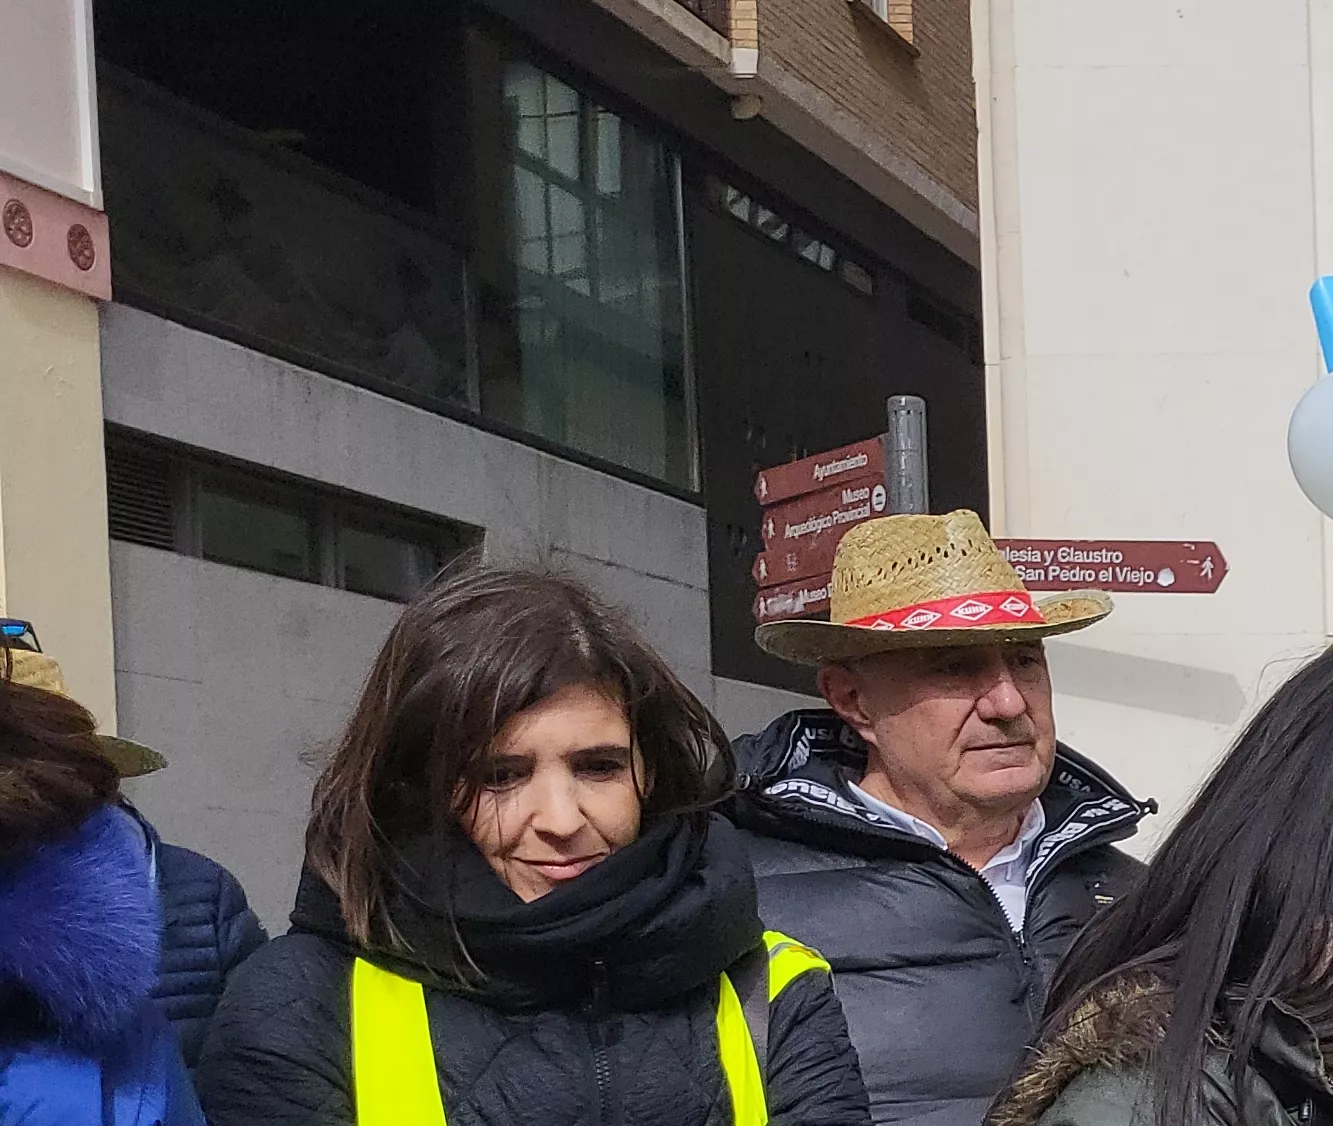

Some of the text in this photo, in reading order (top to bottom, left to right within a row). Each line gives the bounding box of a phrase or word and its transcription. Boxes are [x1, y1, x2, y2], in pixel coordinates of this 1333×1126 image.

[1001, 546, 1123, 567] lesia y Claustro
[1015, 565, 1155, 587] San Pedro el Viejo
